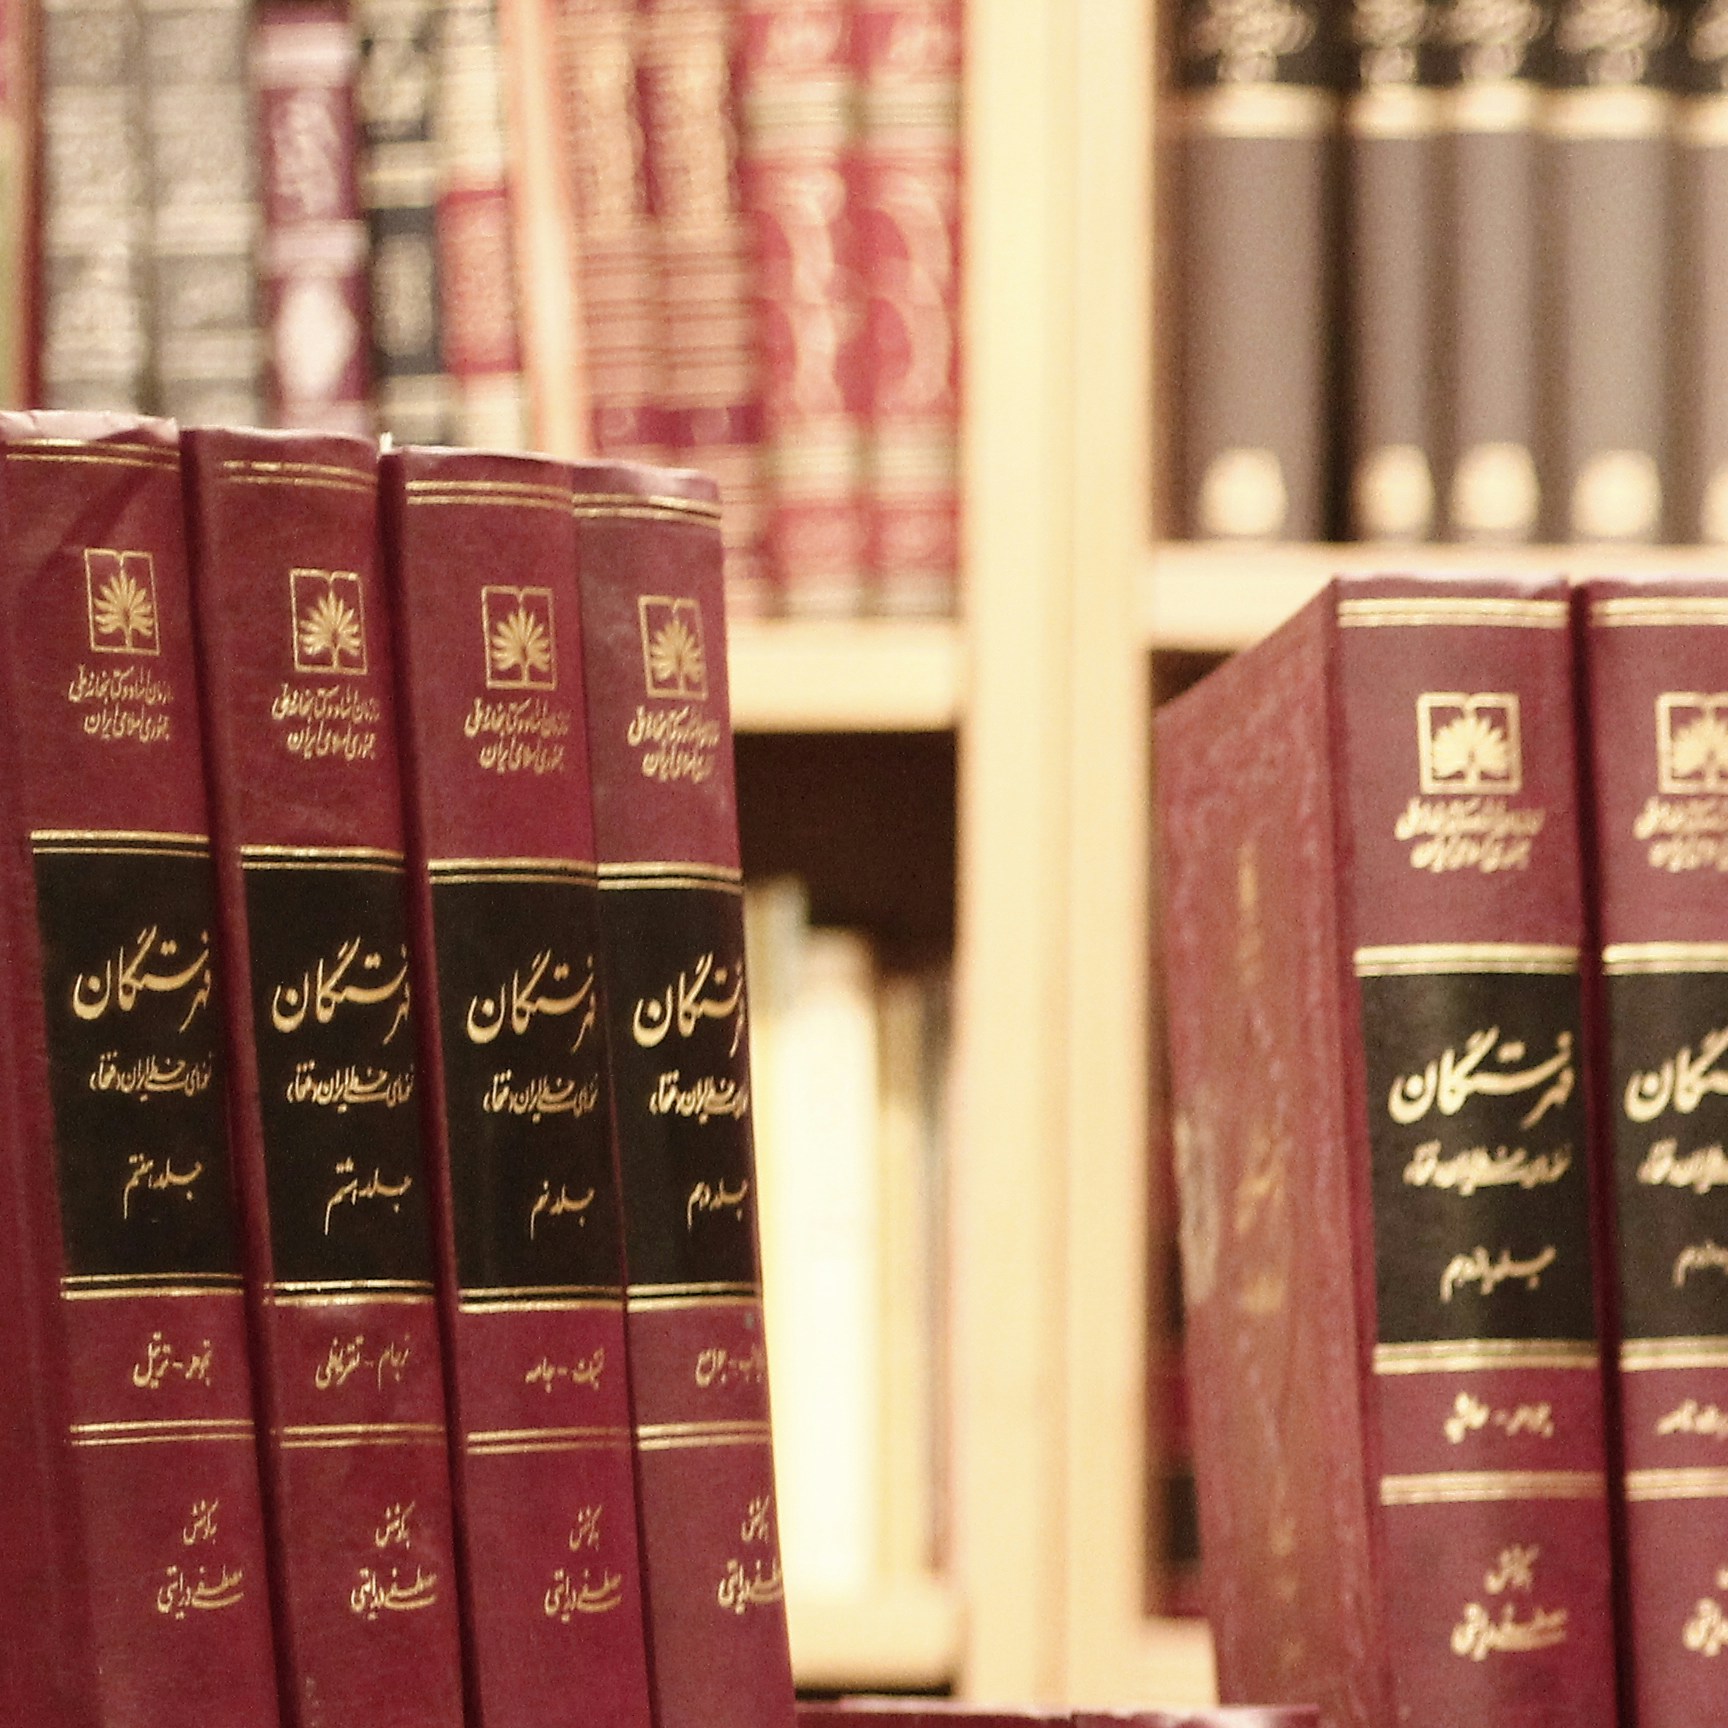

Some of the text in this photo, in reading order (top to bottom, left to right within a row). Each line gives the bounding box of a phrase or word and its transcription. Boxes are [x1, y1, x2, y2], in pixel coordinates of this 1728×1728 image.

[156, 1157, 204, 1201] جلد
[357, 1166, 413, 1214] جلد
[549, 1183, 596, 1228] جلد
